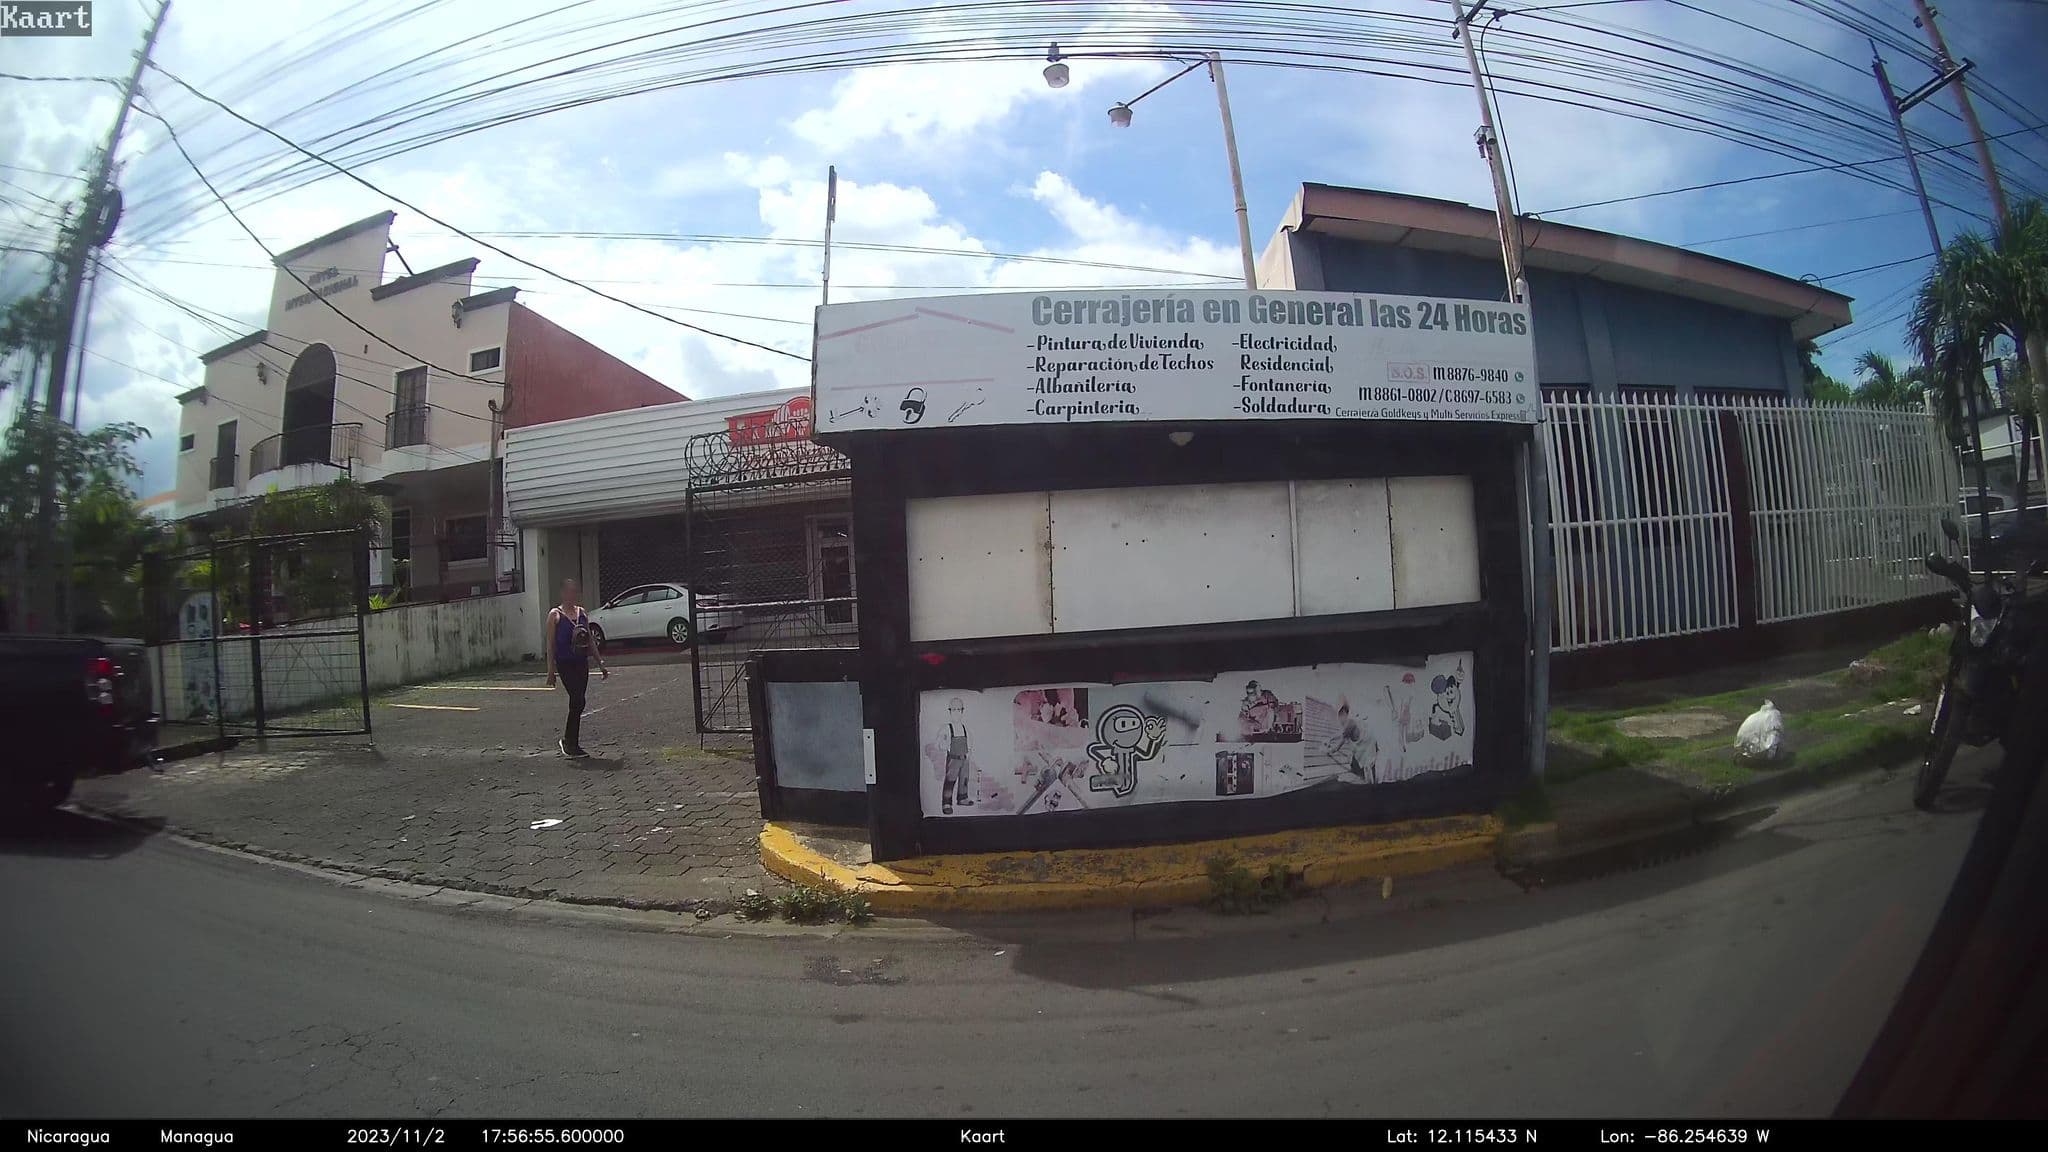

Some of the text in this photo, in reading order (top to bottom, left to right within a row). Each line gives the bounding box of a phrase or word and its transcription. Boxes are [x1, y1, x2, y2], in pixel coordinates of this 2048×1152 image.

[1031, 294, 1527, 336] Cerrajería en General las 24 Horas
[1107, 332, 1128, 350] de
[1129, 332, 1204, 350] Vivienda
[1139, 353, 1159, 371] de
[1158, 353, 1215, 371] Techos
[1240, 353, 1334, 373] Residencial
[1380, 407, 1421, 421] Goldkeys
